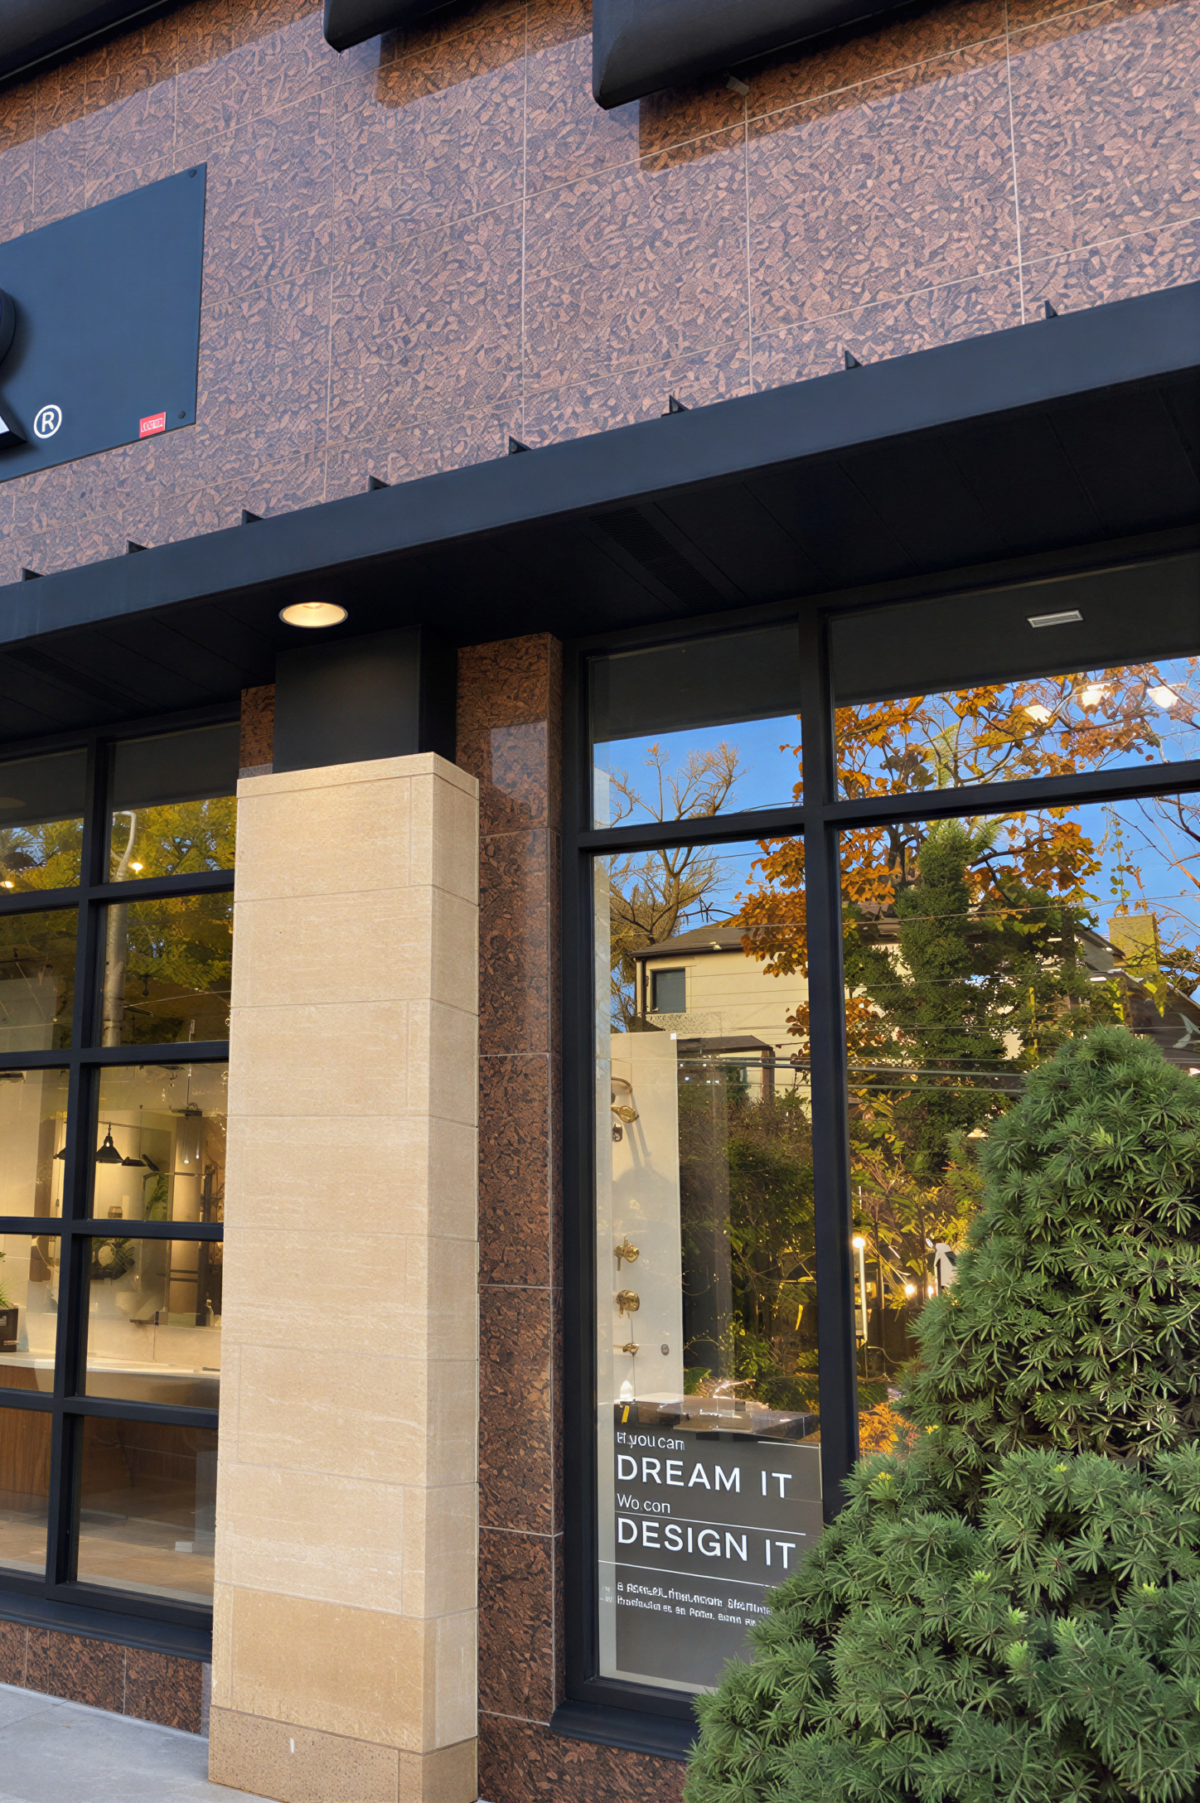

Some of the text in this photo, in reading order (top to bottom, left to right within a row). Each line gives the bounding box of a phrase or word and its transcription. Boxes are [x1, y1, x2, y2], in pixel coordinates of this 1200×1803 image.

[657, 1437, 686, 1451] can
[616, 1454, 793, 1499] DREAM IT
[616, 1517, 797, 1570] DESIGN IT
